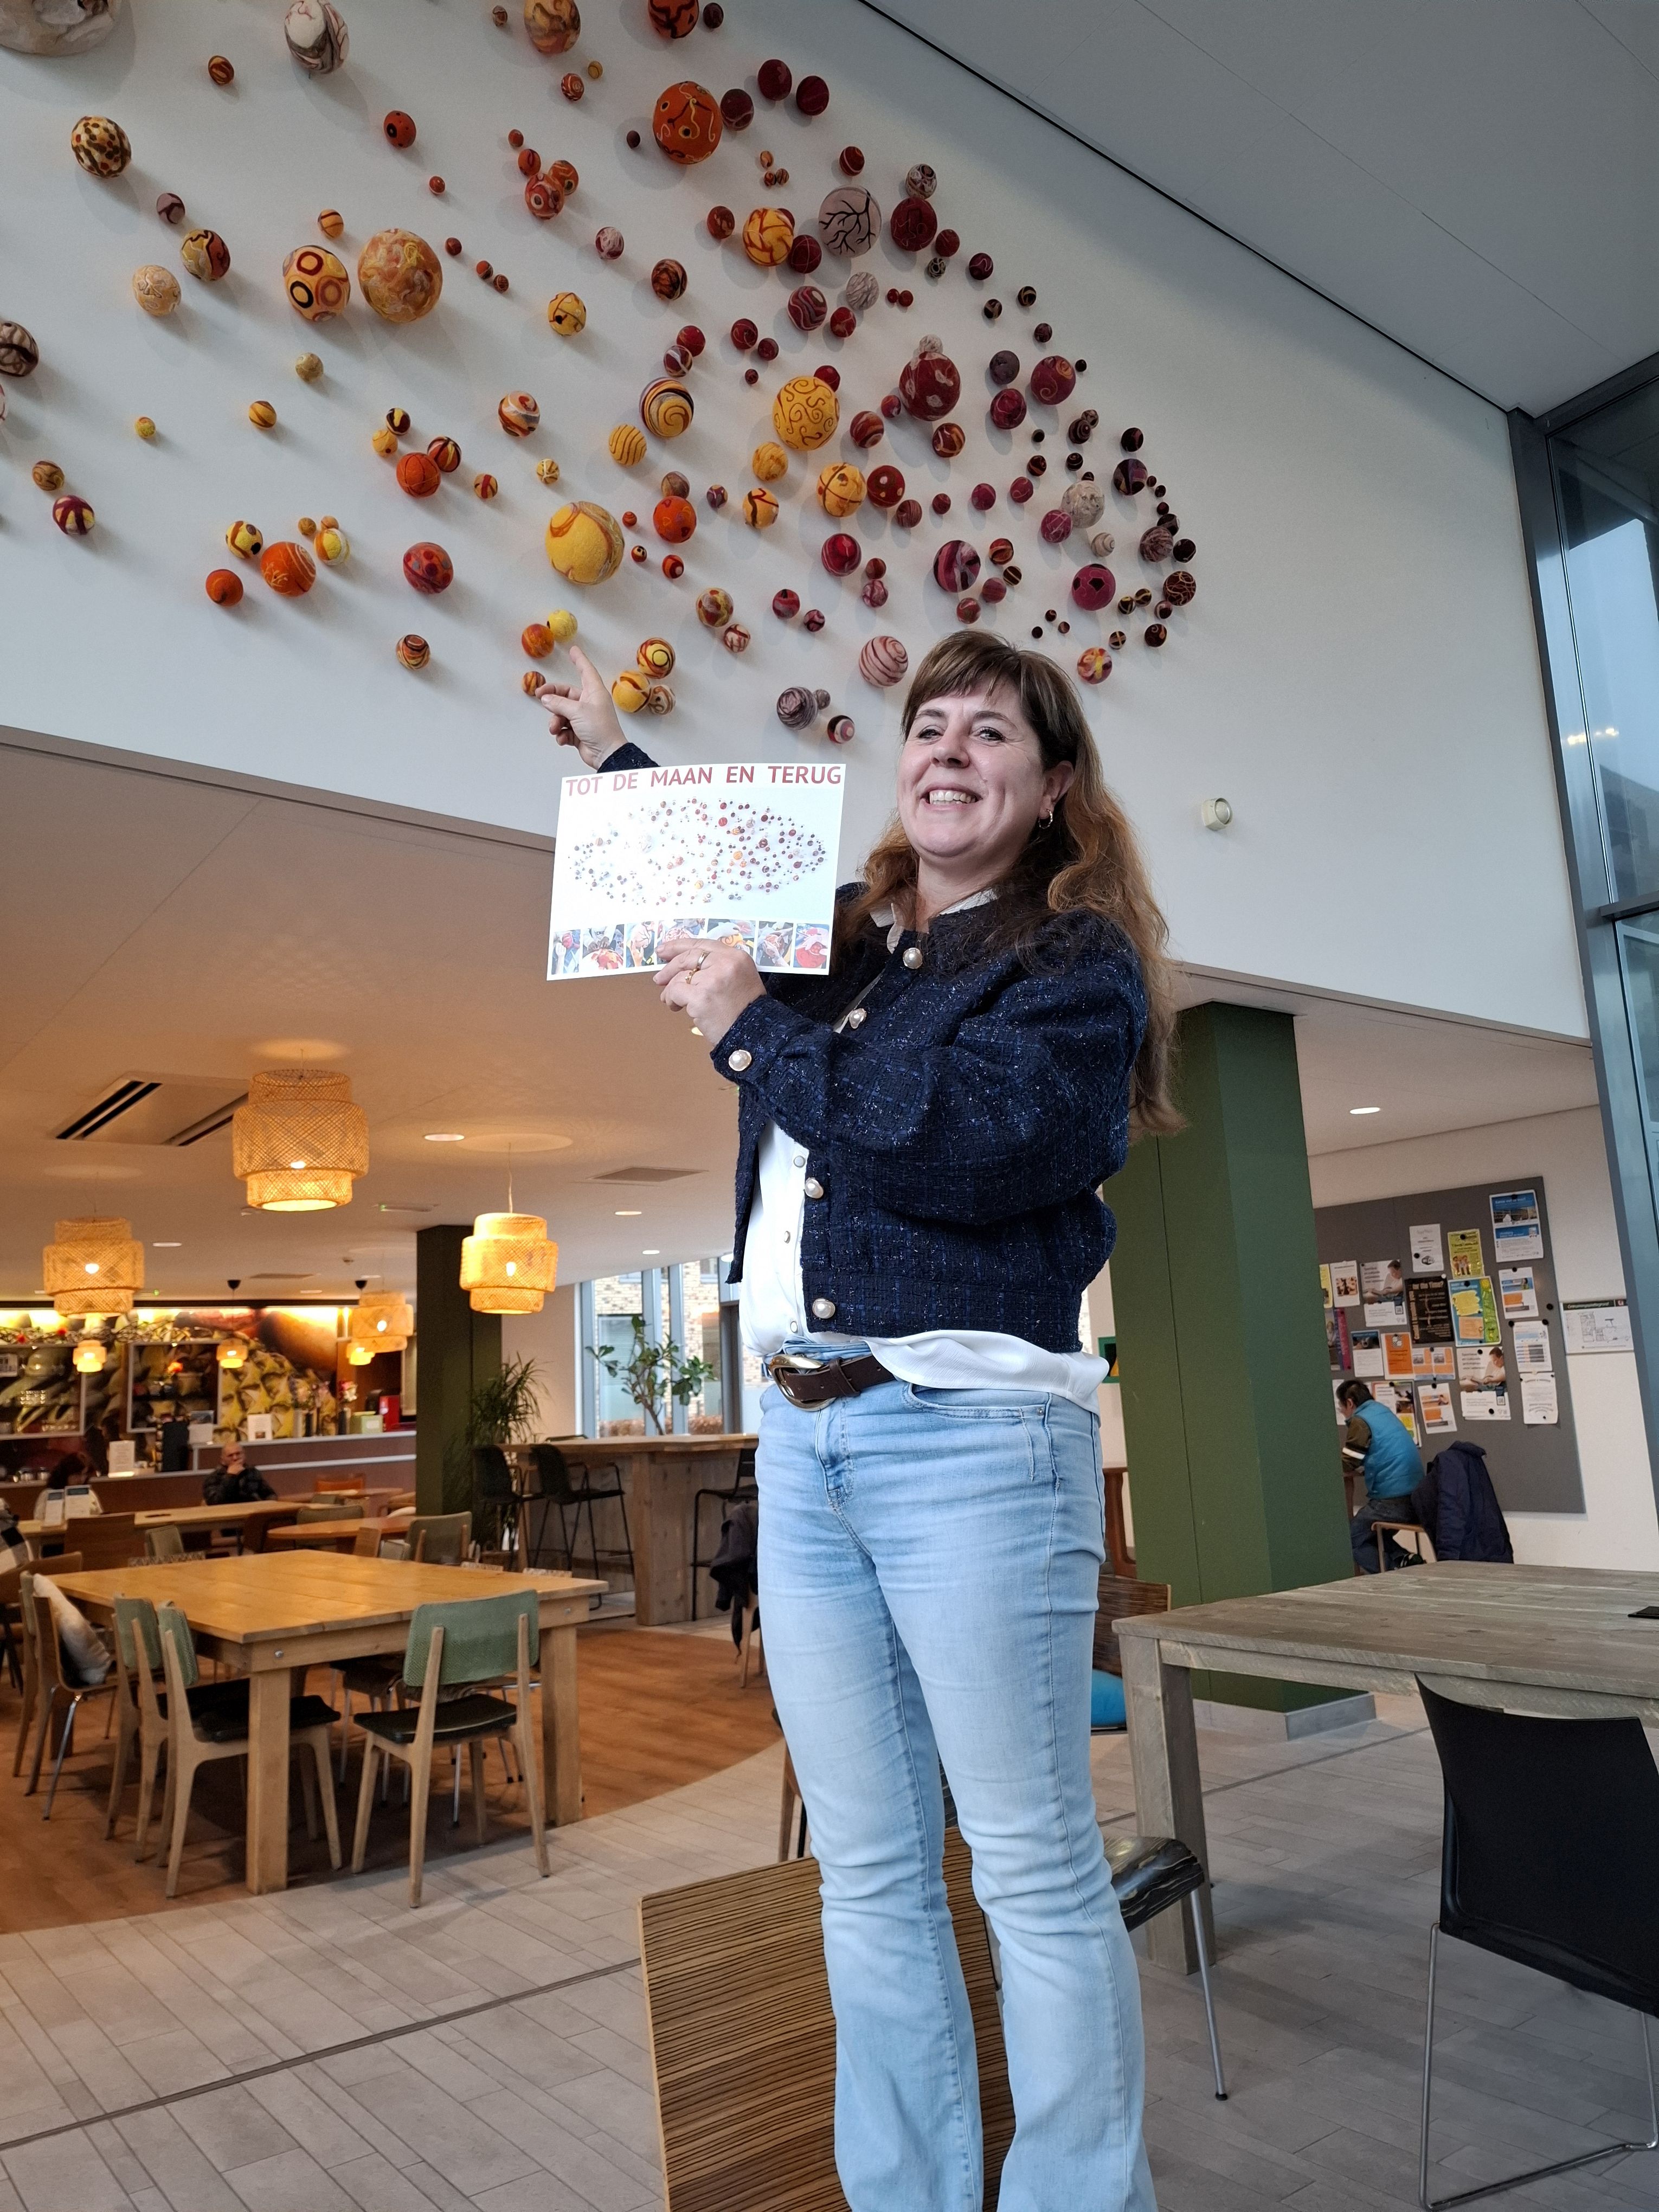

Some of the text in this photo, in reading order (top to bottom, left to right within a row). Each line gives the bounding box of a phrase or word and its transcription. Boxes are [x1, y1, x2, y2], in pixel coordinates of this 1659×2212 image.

[566, 766, 841, 796] TOT DE MAAN EN TERUG
